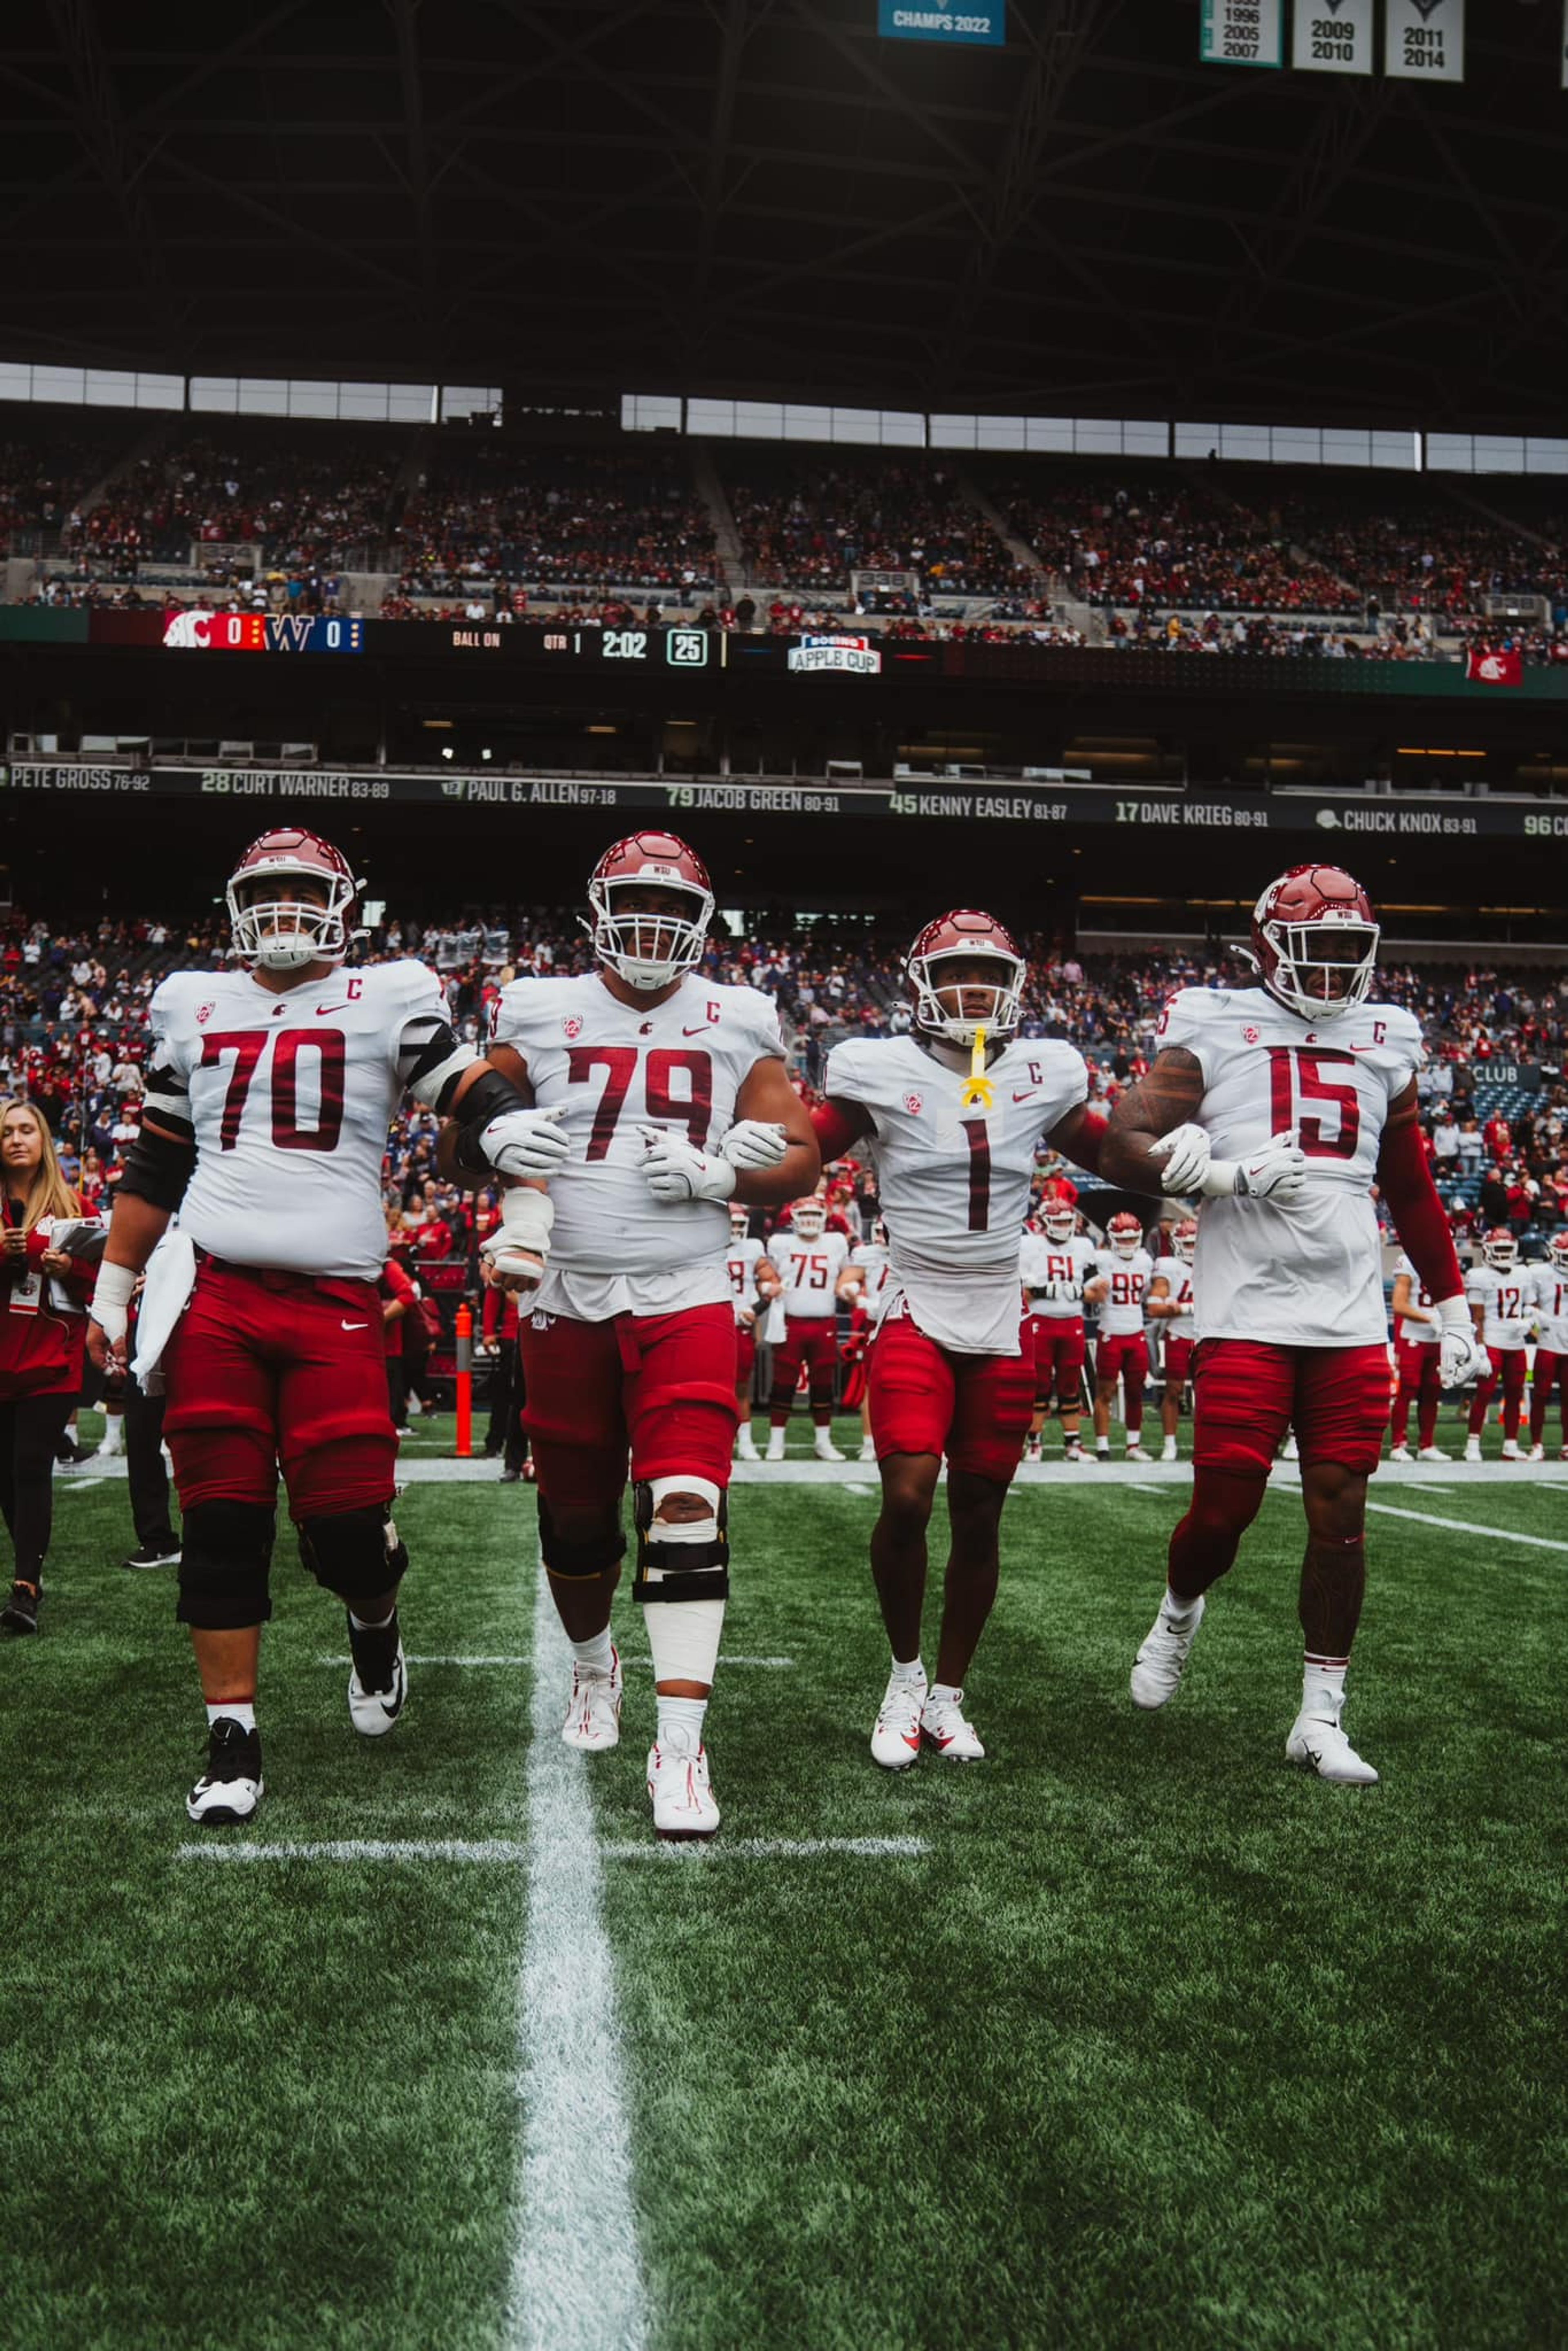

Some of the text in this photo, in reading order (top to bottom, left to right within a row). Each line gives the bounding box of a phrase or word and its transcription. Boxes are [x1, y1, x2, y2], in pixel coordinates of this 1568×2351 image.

[893, 10, 991, 33] CHAMPS 2022
[1224, 8, 1259, 23] 1996
[1223, 25, 1259, 41] 2005
[1312, 20, 1354, 40] 2009
[1404, 27, 1443, 47] 2011
[1224, 42, 1259, 58] 2007
[1312, 42, 1353, 61] 2010
[1404, 49, 1445, 67] 2014
[227, 617, 241, 644] 0
[263, 614, 315, 651] W
[327, 620, 340, 648] 0
[453, 631, 500, 647] BALL ON
[543, 633, 581, 654] QTR 1
[602, 631, 647, 658] 2:02
[675, 635, 700, 661] 25
[795, 651, 874, 671] APPLE CUP
[11, 768, 52, 788] PETE
[56, 769, 111, 790] GROSS
[202, 773, 389, 798] 28 CURT WARNER 83-89
[468, 781, 508, 802] PAUL
[512, 782, 526, 802] G.
[530, 783, 579, 804] ALLEN
[580, 789, 616, 805] 97-18
[666, 788, 840, 812] 79 JACOB GREEN 80-91
[889, 794, 1067, 820] 45 KENNY EASLEY 81-87
[1115, 802, 1269, 827] 17 DAVE KRIEG 80-91
[1344, 810, 1395, 831] CHUCK
[1399, 813, 1441, 833] KNOX
[1524, 815, 1551, 836] 96
[347, 979, 362, 999] C
[707, 1001, 720, 1023] C
[1373, 1021, 1386, 1043] C
[1028, 1062, 1042, 1084] C
[1473, 1066, 1517, 1082] CLUB
[200, 1029, 345, 1152] 70
[567, 1047, 712, 1162] 79
[1266, 1046, 1360, 1160] 15
[960, 1119, 991, 1231] 1
[790, 1254, 828, 1289] 75
[1047, 1255, 1074, 1282] 61
[1111, 1273, 1144, 1304] 98
[1497, 1288, 1520, 1318] 12
